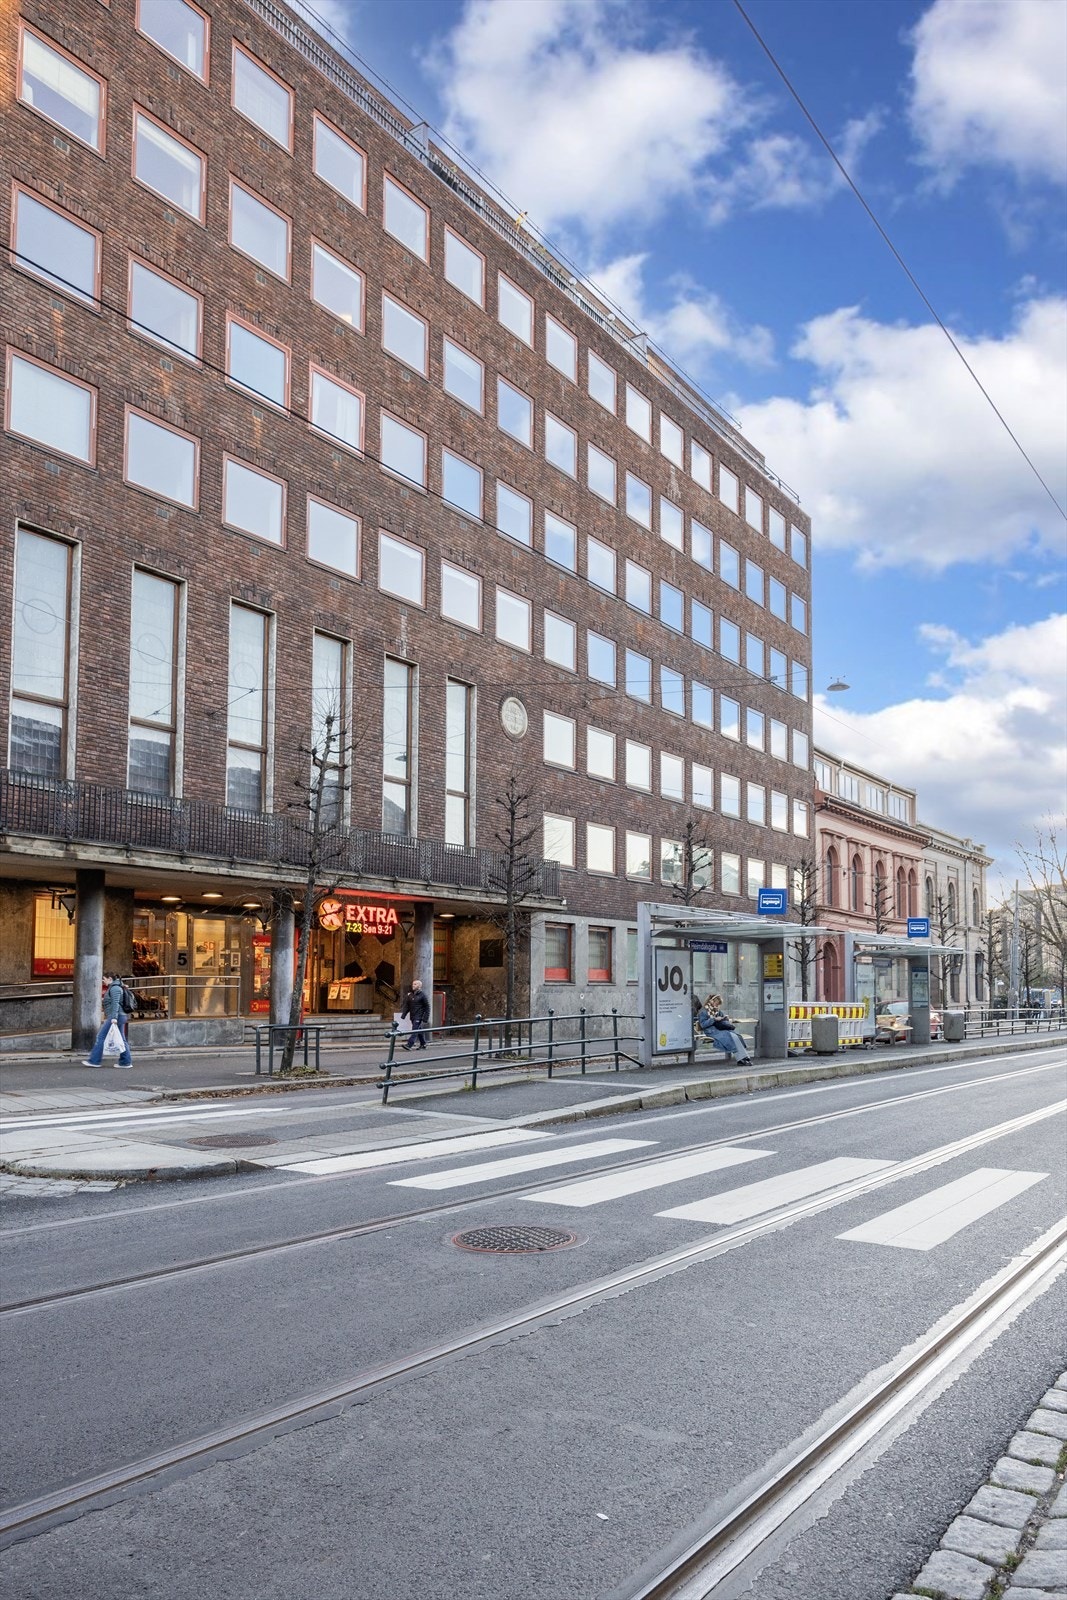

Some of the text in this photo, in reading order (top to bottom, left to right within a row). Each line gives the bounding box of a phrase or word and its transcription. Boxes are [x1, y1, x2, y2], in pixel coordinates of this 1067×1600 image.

[346, 904, 398, 924] EXTRA
[346, 922, 362, 933] 7-23
[377, 925, 392, 935] 9-21
[177, 952, 187, 966] 5
[658, 965, 688, 995] JO,
